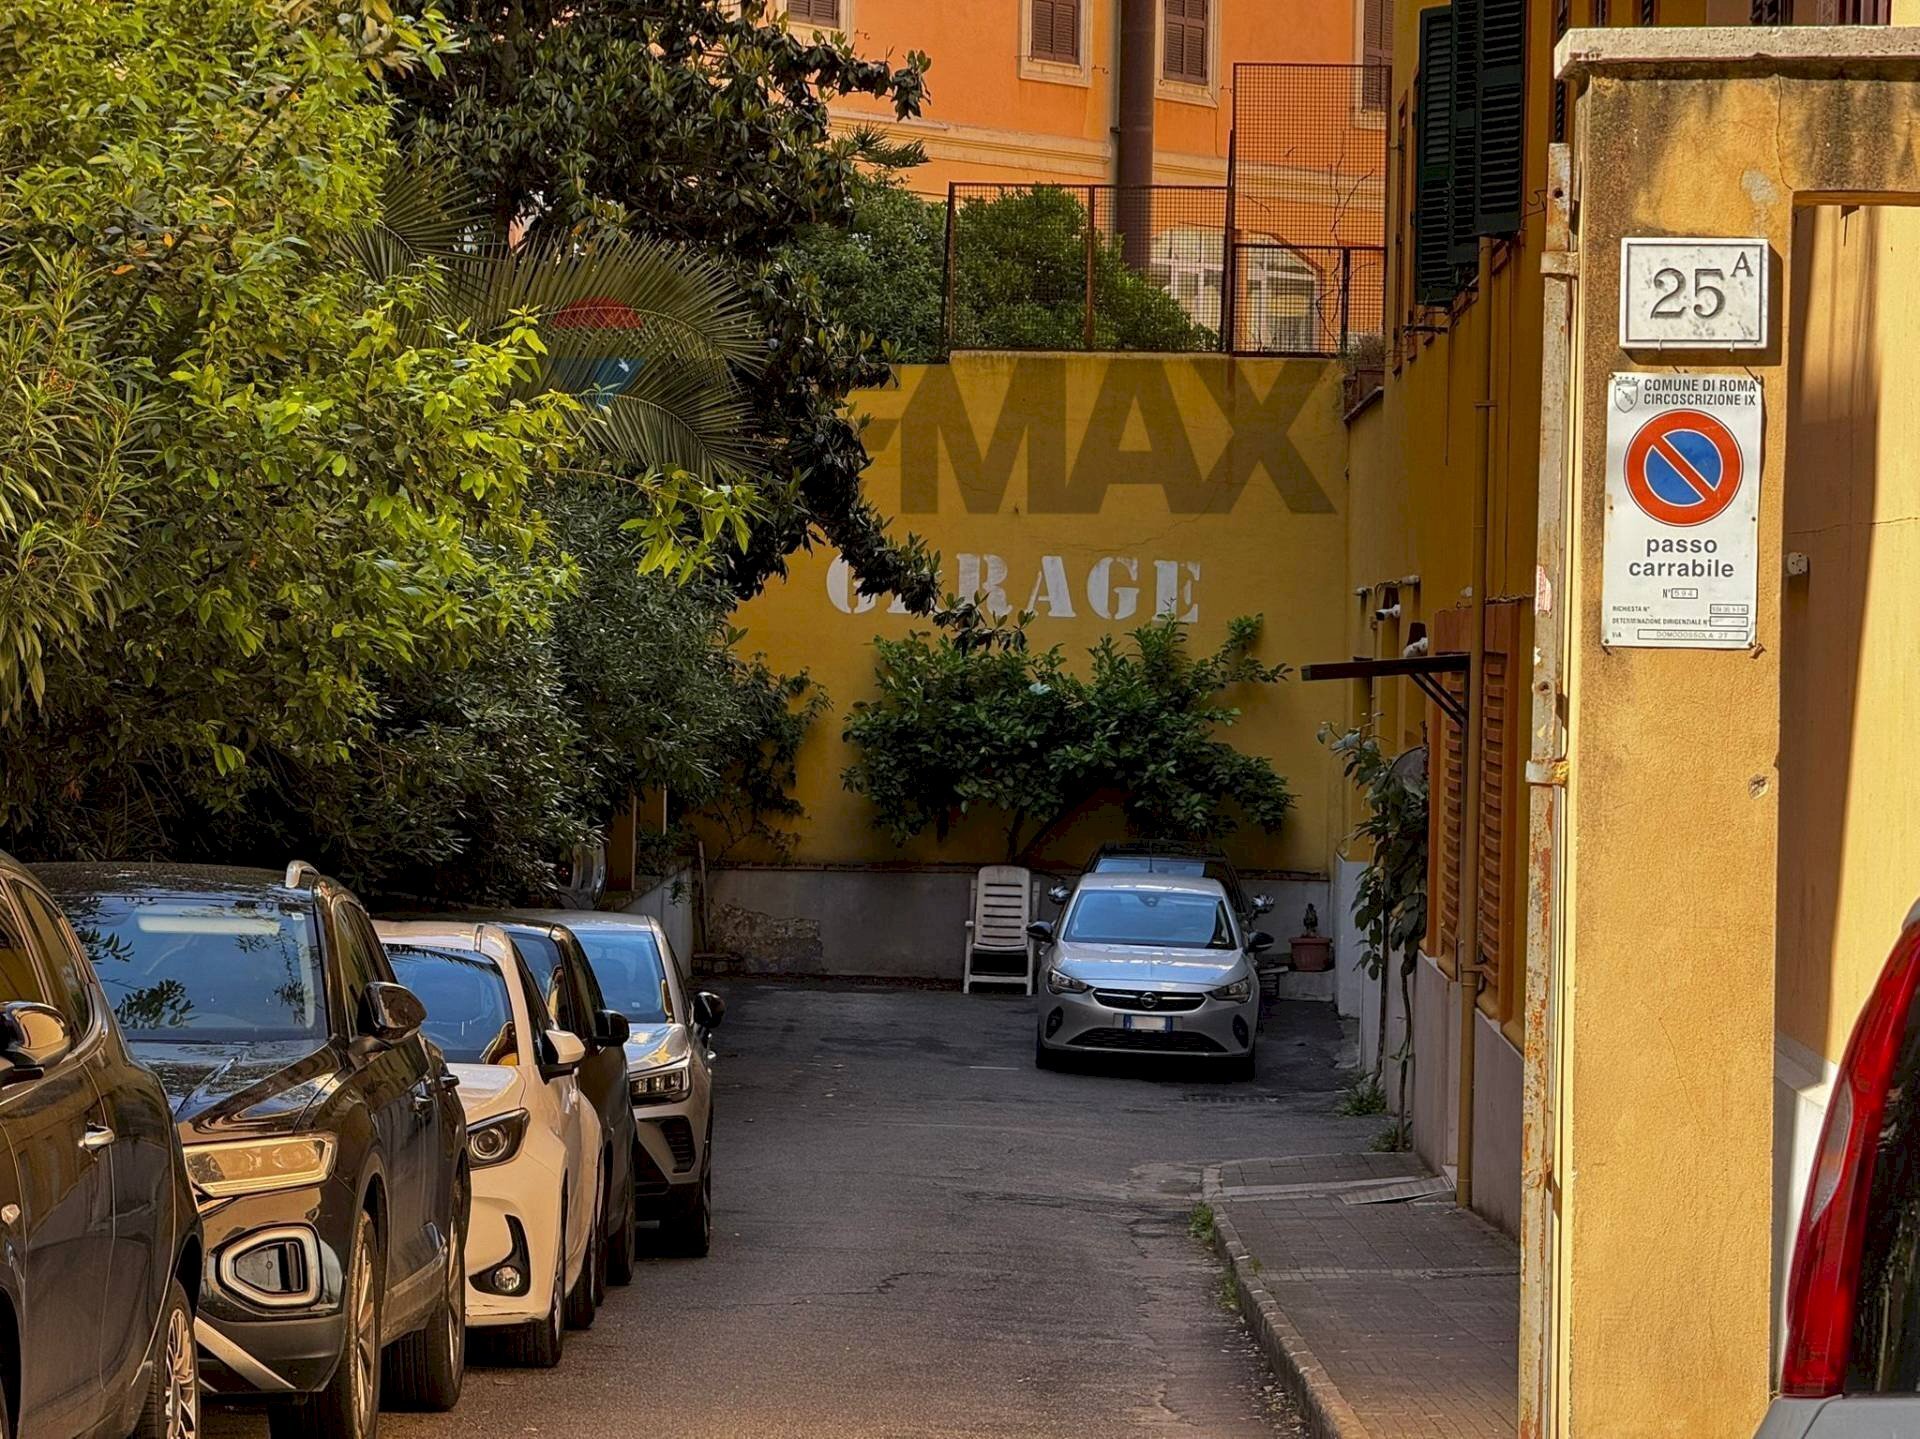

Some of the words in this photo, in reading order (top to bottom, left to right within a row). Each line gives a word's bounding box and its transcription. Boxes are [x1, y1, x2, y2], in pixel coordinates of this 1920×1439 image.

[1644, 379, 1698, 392] COMUNE
[1703, 379, 1715, 392] DI
[1719, 379, 1757, 393] ROMA
[1643, 394, 1743, 406] CIRCOSCRIZIONE
[1745, 395, 1756, 406] IX
[1646, 537, 1718, 557] passo
[1628, 559, 1735, 578] carrabile
